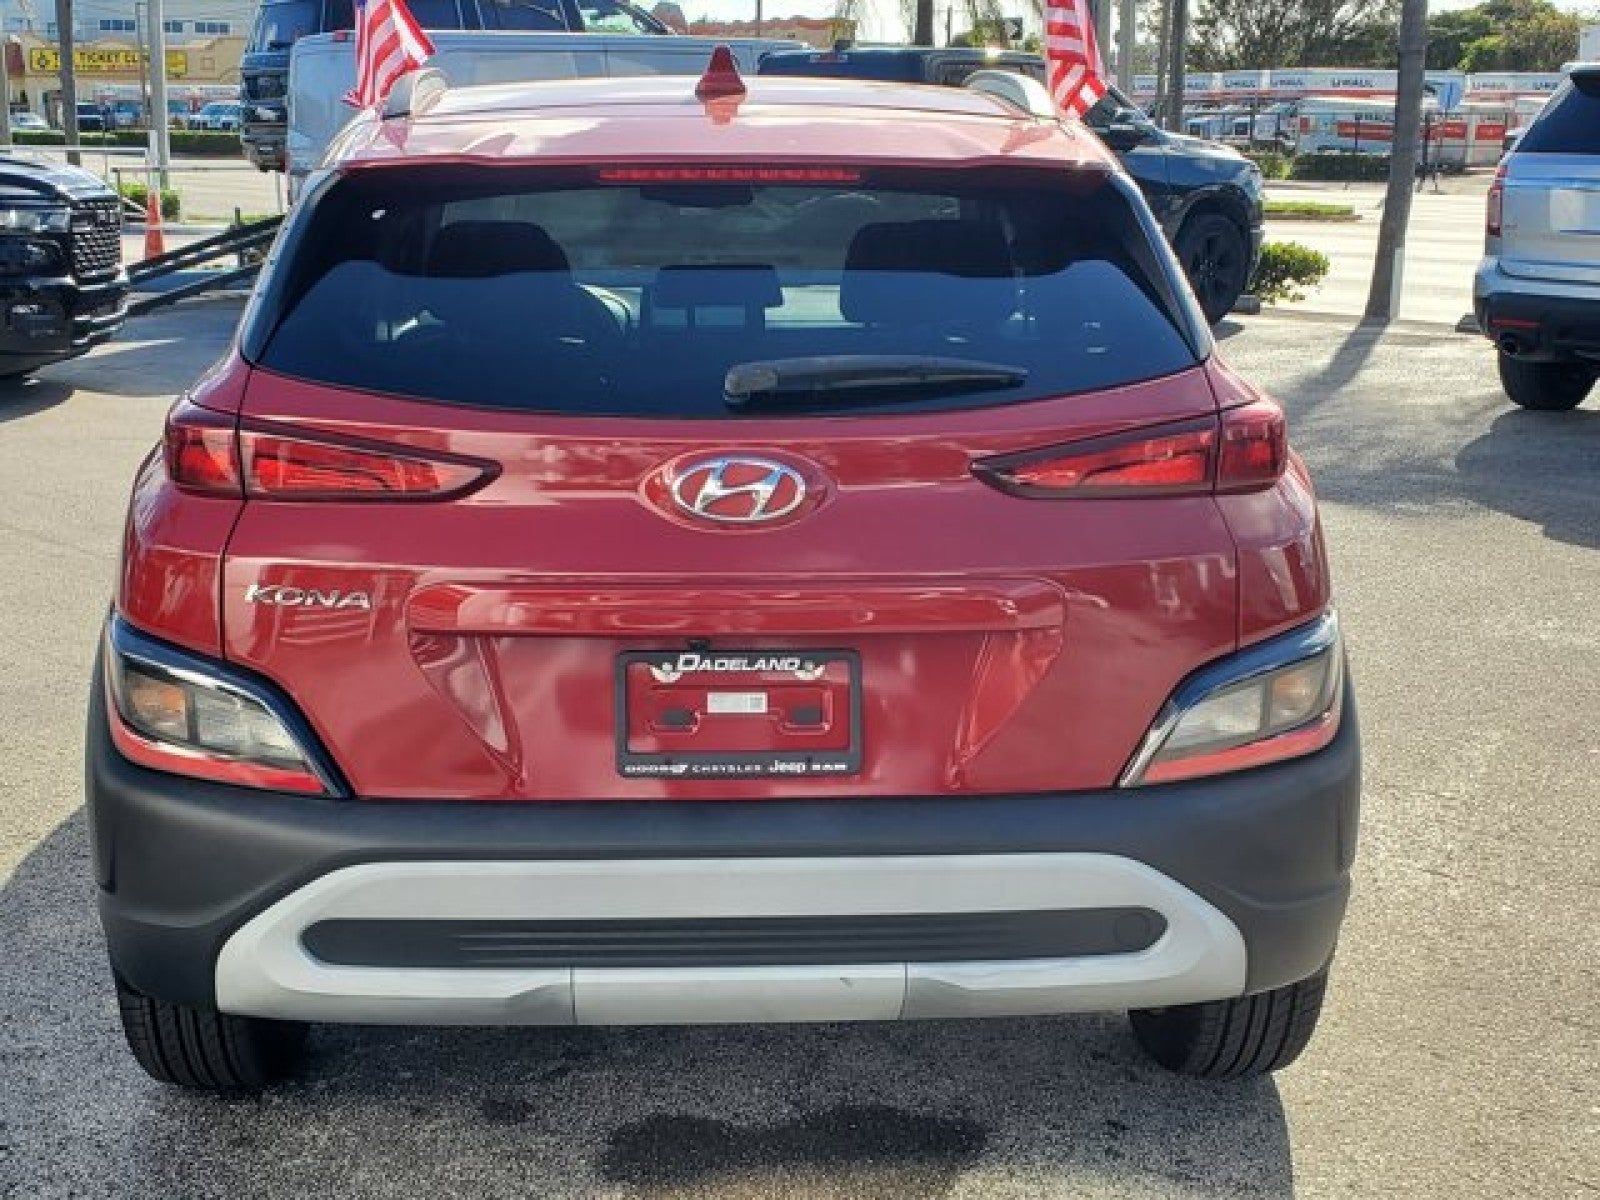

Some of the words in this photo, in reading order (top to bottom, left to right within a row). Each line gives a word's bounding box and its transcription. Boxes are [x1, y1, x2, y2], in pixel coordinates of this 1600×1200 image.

[244, 584, 371, 609] KONA
[677, 654, 801, 672] DADELAND
[691, 764, 762, 774] CHRYSLER
[769, 760, 806, 774] Jeep
